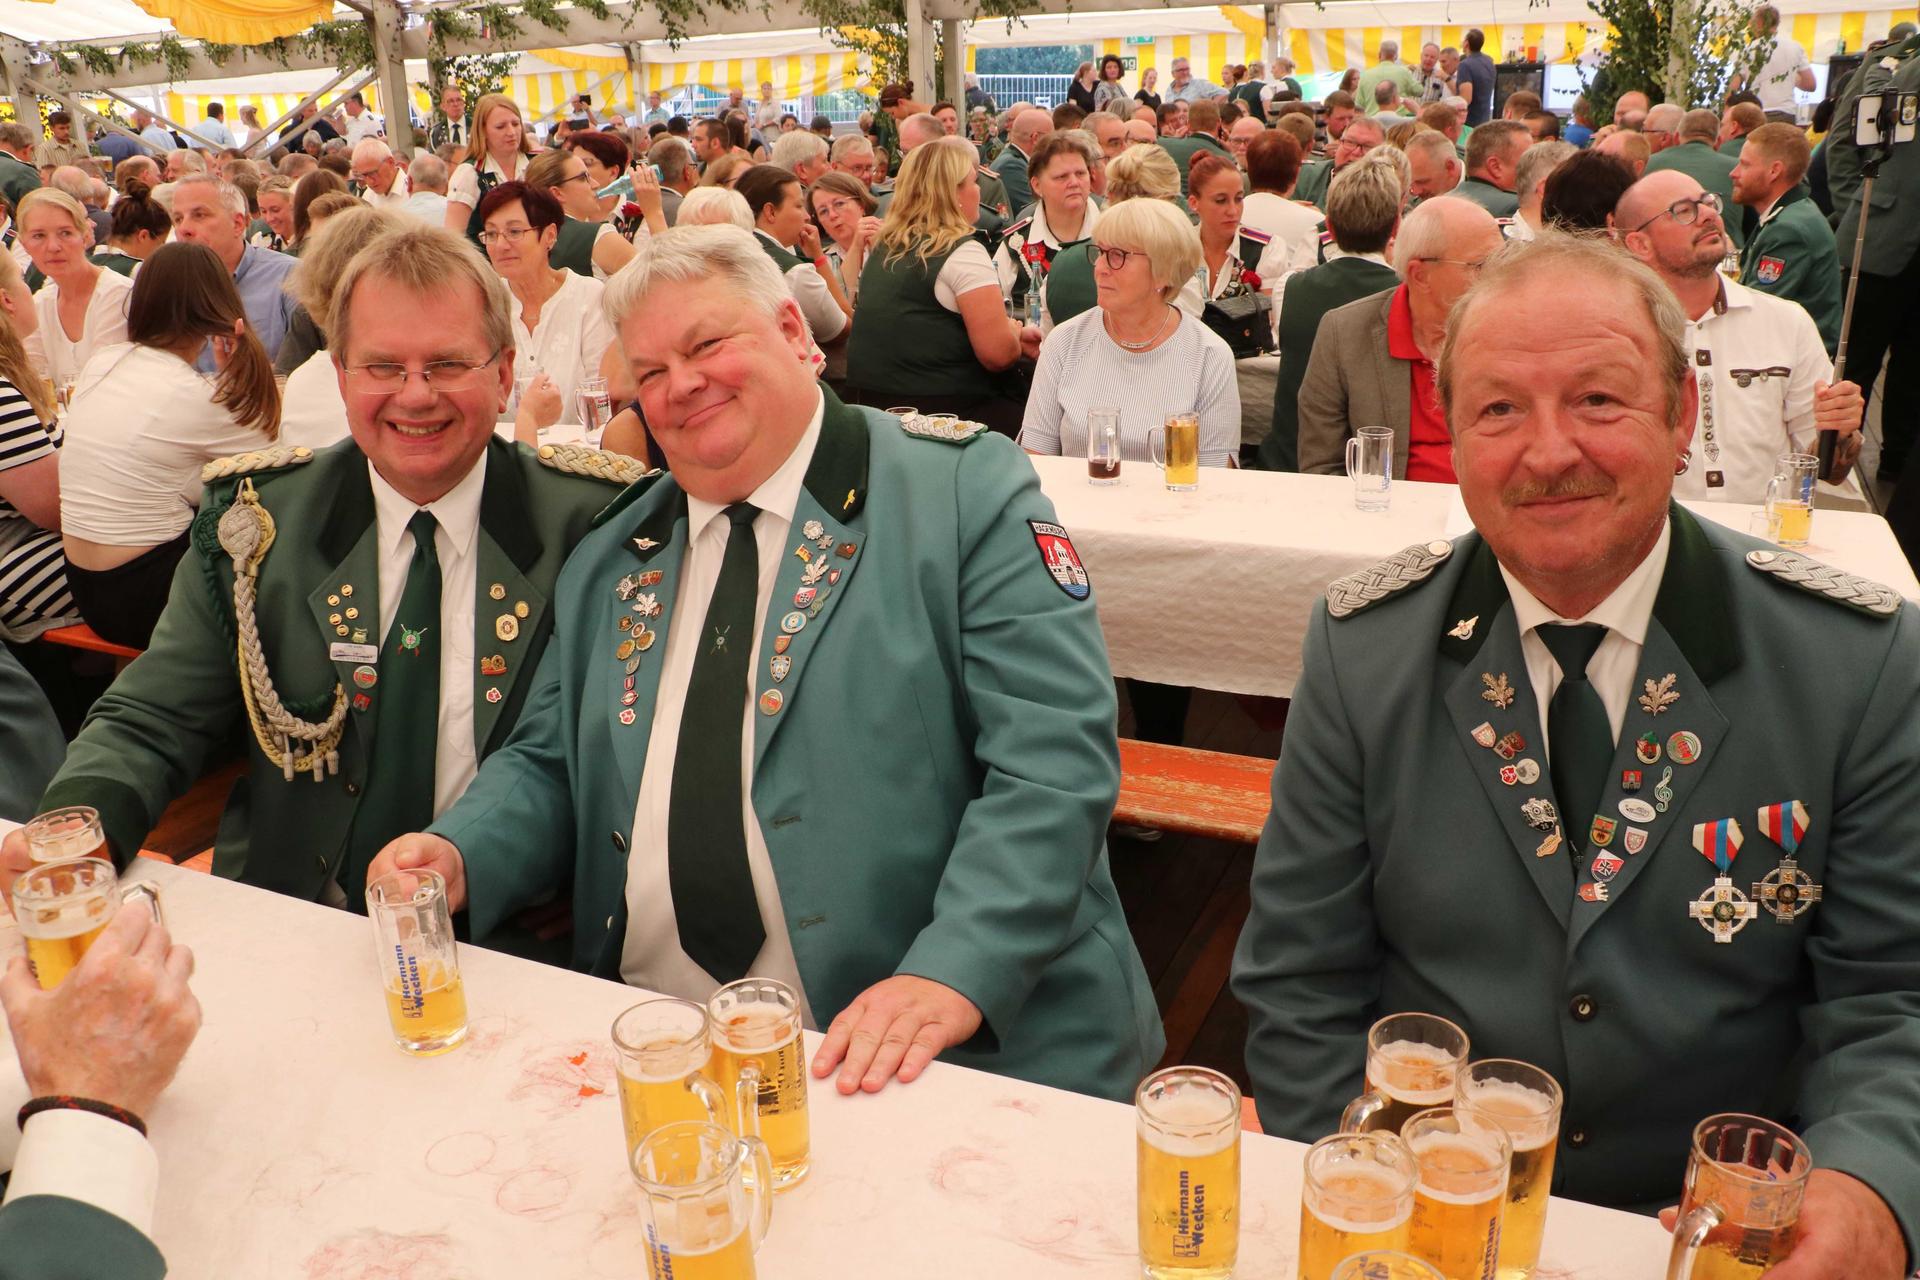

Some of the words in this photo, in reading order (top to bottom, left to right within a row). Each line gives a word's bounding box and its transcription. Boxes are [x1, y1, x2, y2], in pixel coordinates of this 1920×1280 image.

[395, 944, 412, 999] Hermann
[408, 955, 425, 1009] Wecken
[1178, 1170, 1189, 1235] Hermann
[1191, 1184, 1205, 1248] Wecken
